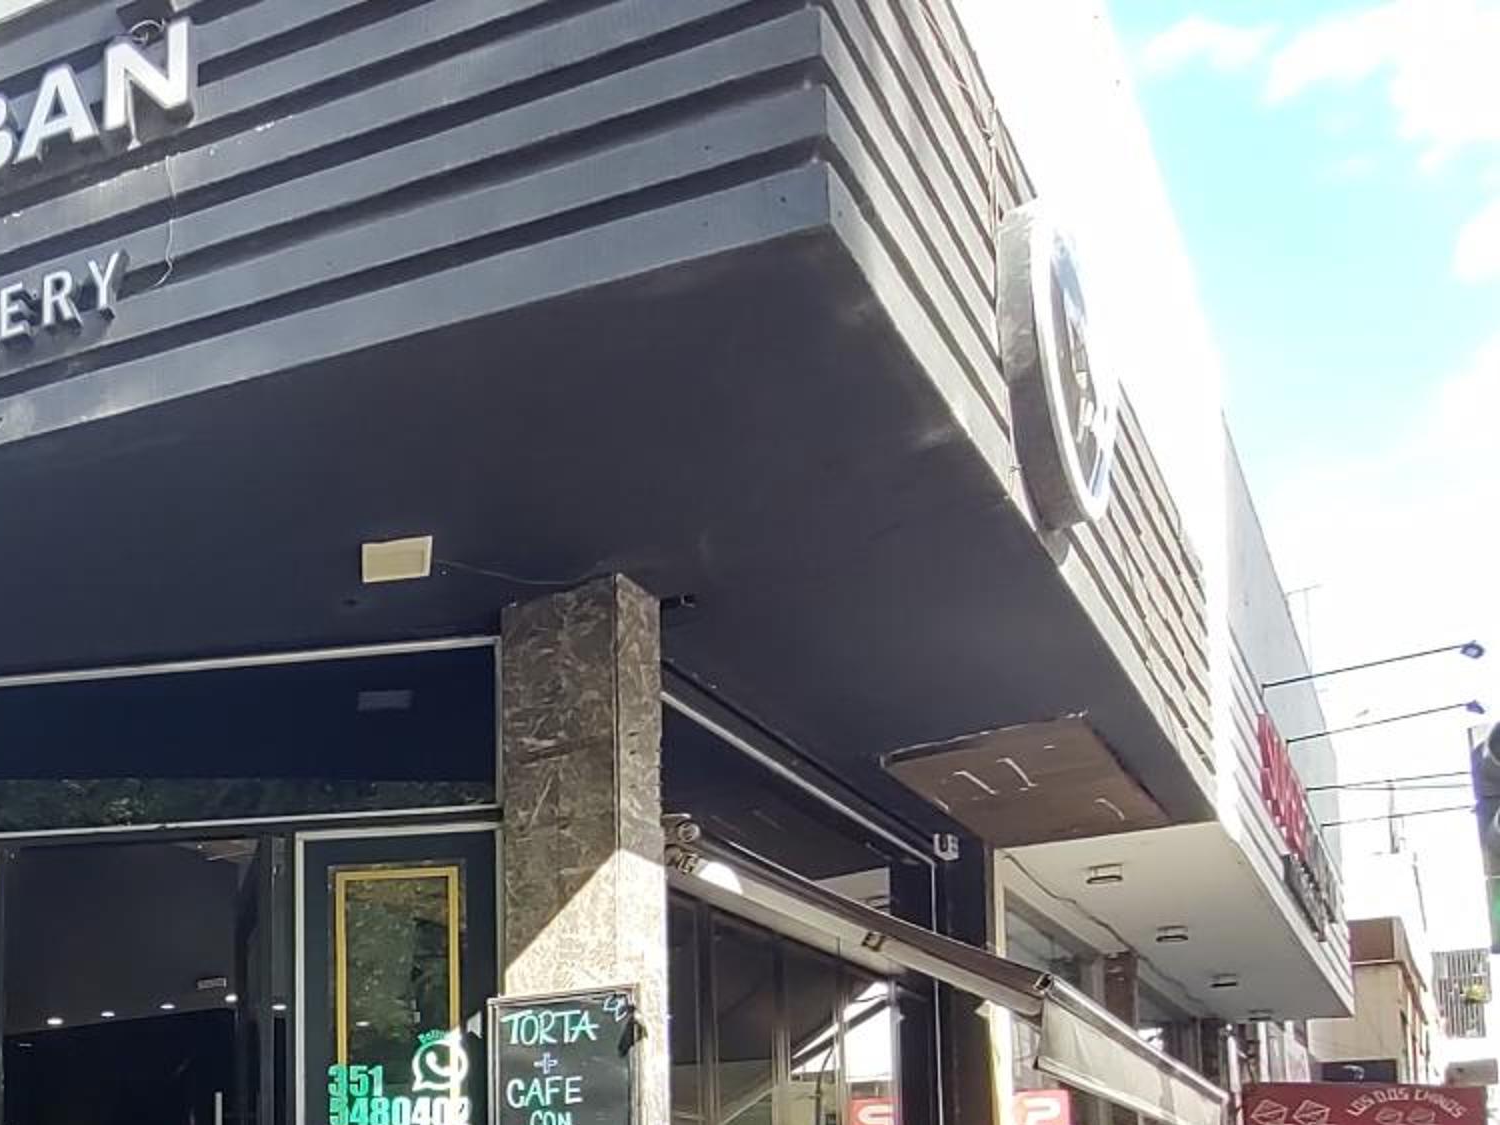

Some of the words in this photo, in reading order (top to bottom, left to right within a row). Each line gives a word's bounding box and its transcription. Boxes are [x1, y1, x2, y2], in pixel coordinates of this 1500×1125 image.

[500, 1009, 599, 1045] TORTA
[326, 1063, 384, 1097] 351
[506, 1075, 584, 1109] CAFE
[1347, 1094, 1376, 1117] LOS
[1372, 1087, 1409, 1103] DOS
